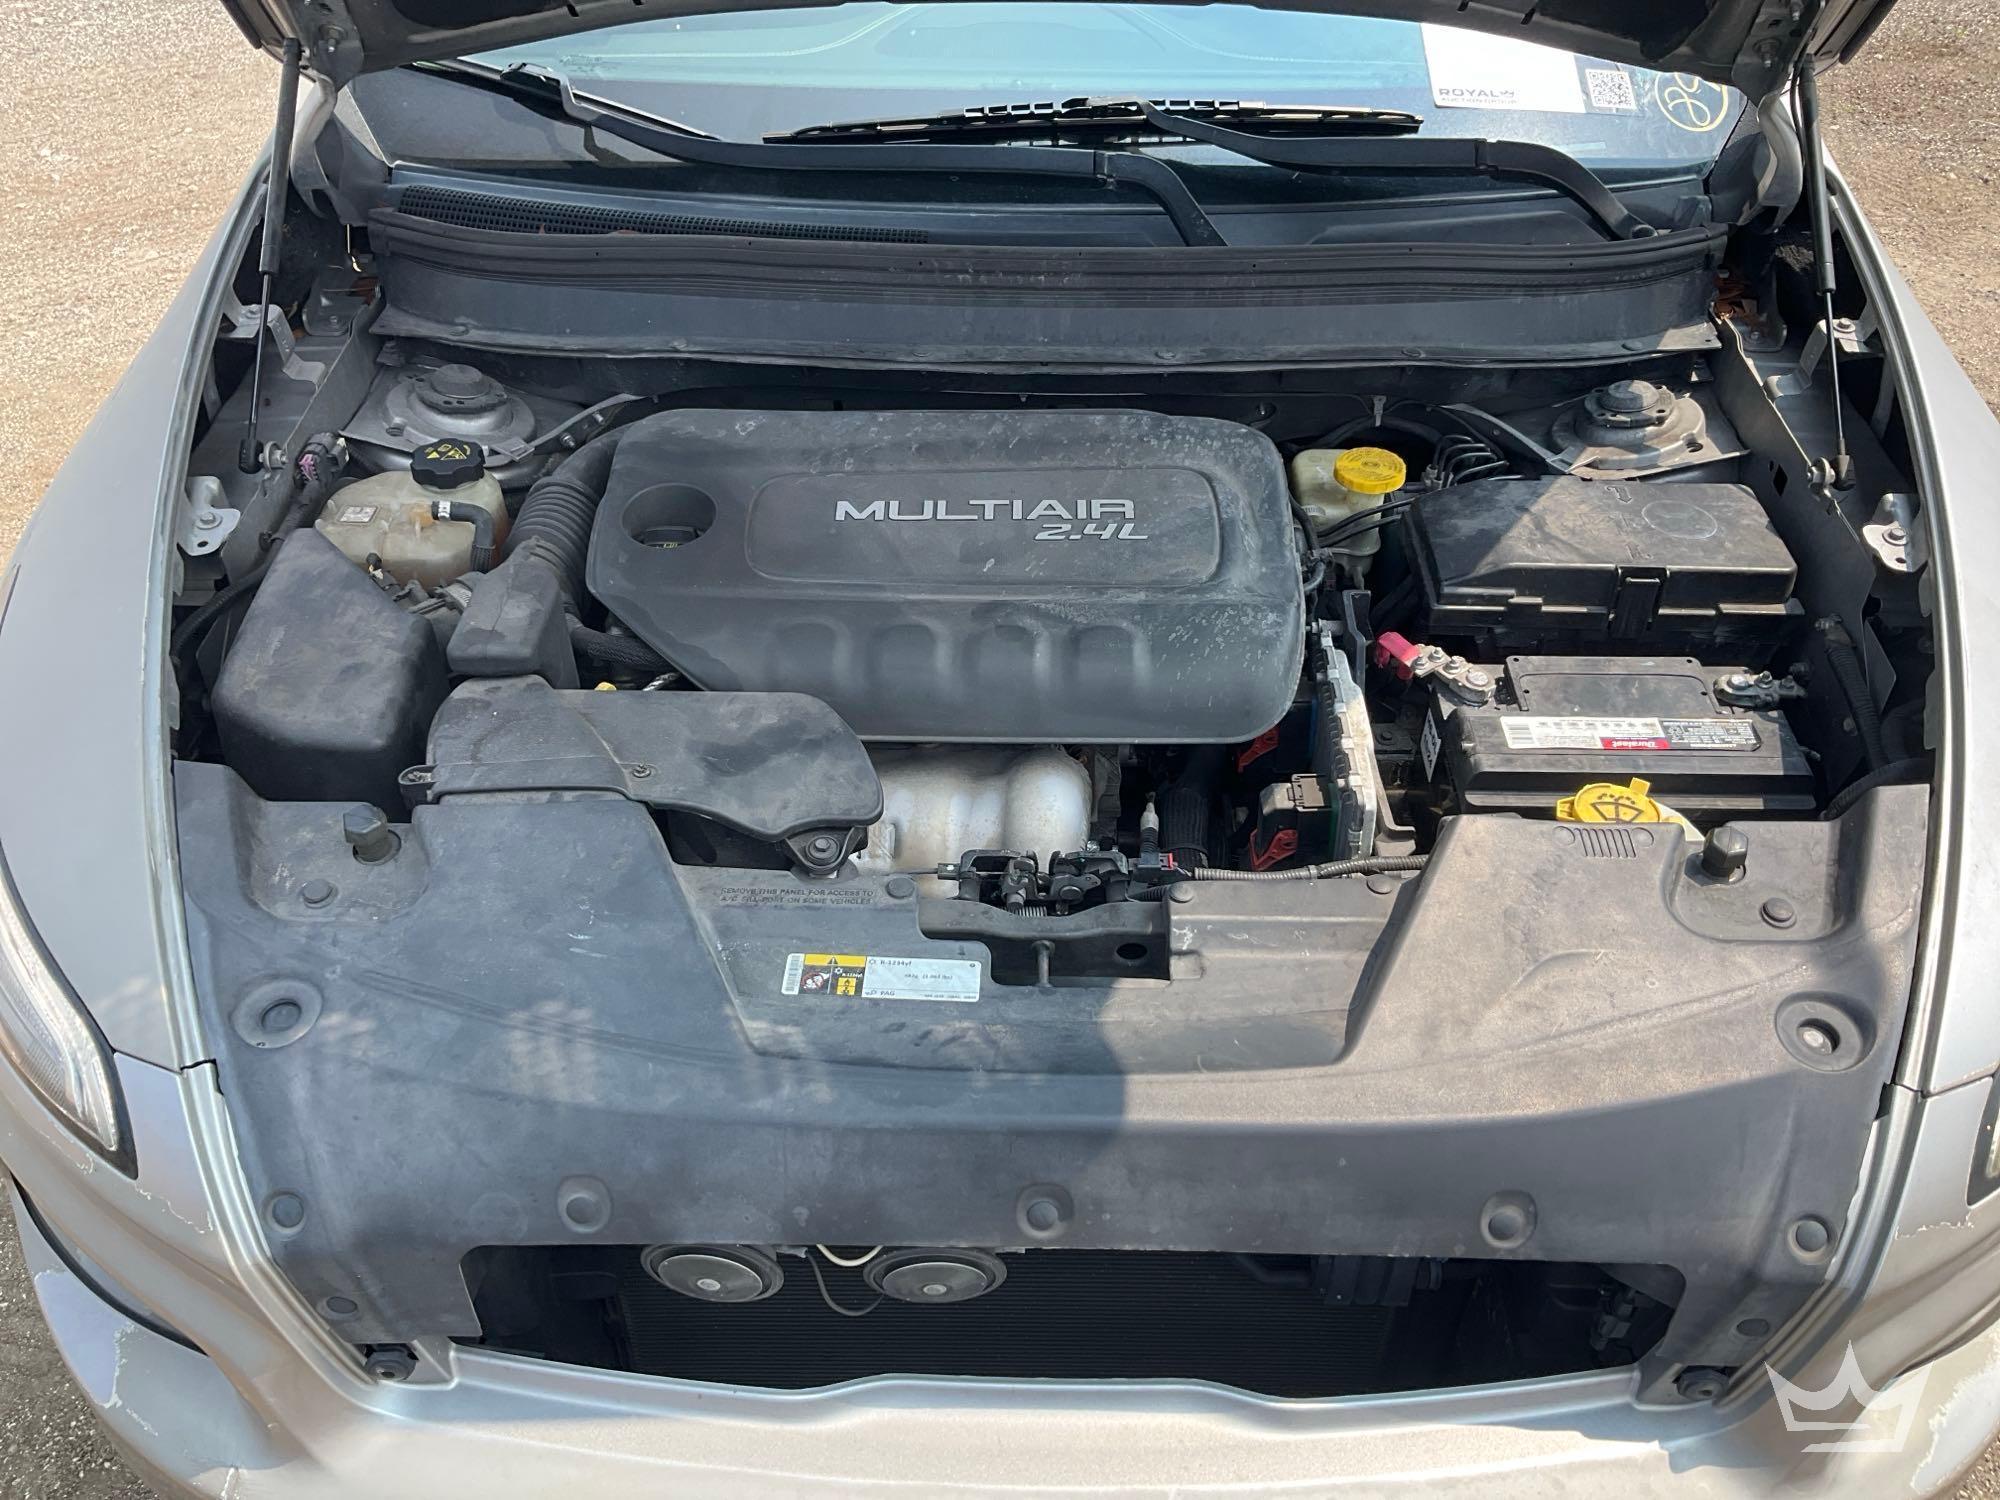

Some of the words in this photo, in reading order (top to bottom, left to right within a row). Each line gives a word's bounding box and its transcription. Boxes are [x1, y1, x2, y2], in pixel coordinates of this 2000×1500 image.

[1439, 88, 1499, 97] ROYAL
[835, 499, 1135, 521] MULTIAIR
[1034, 523, 1149, 540] 2.4L
[1611, 740, 1657, 749] Duralast
[758, 888, 778, 896] THIS
[780, 888, 806, 896] PANEL
[808, 889, 826, 897] FOR
[827, 889, 860, 897] ACCESS
[862, 889, 874, 897] TO
[830, 897, 873, 905] VEHICLES
